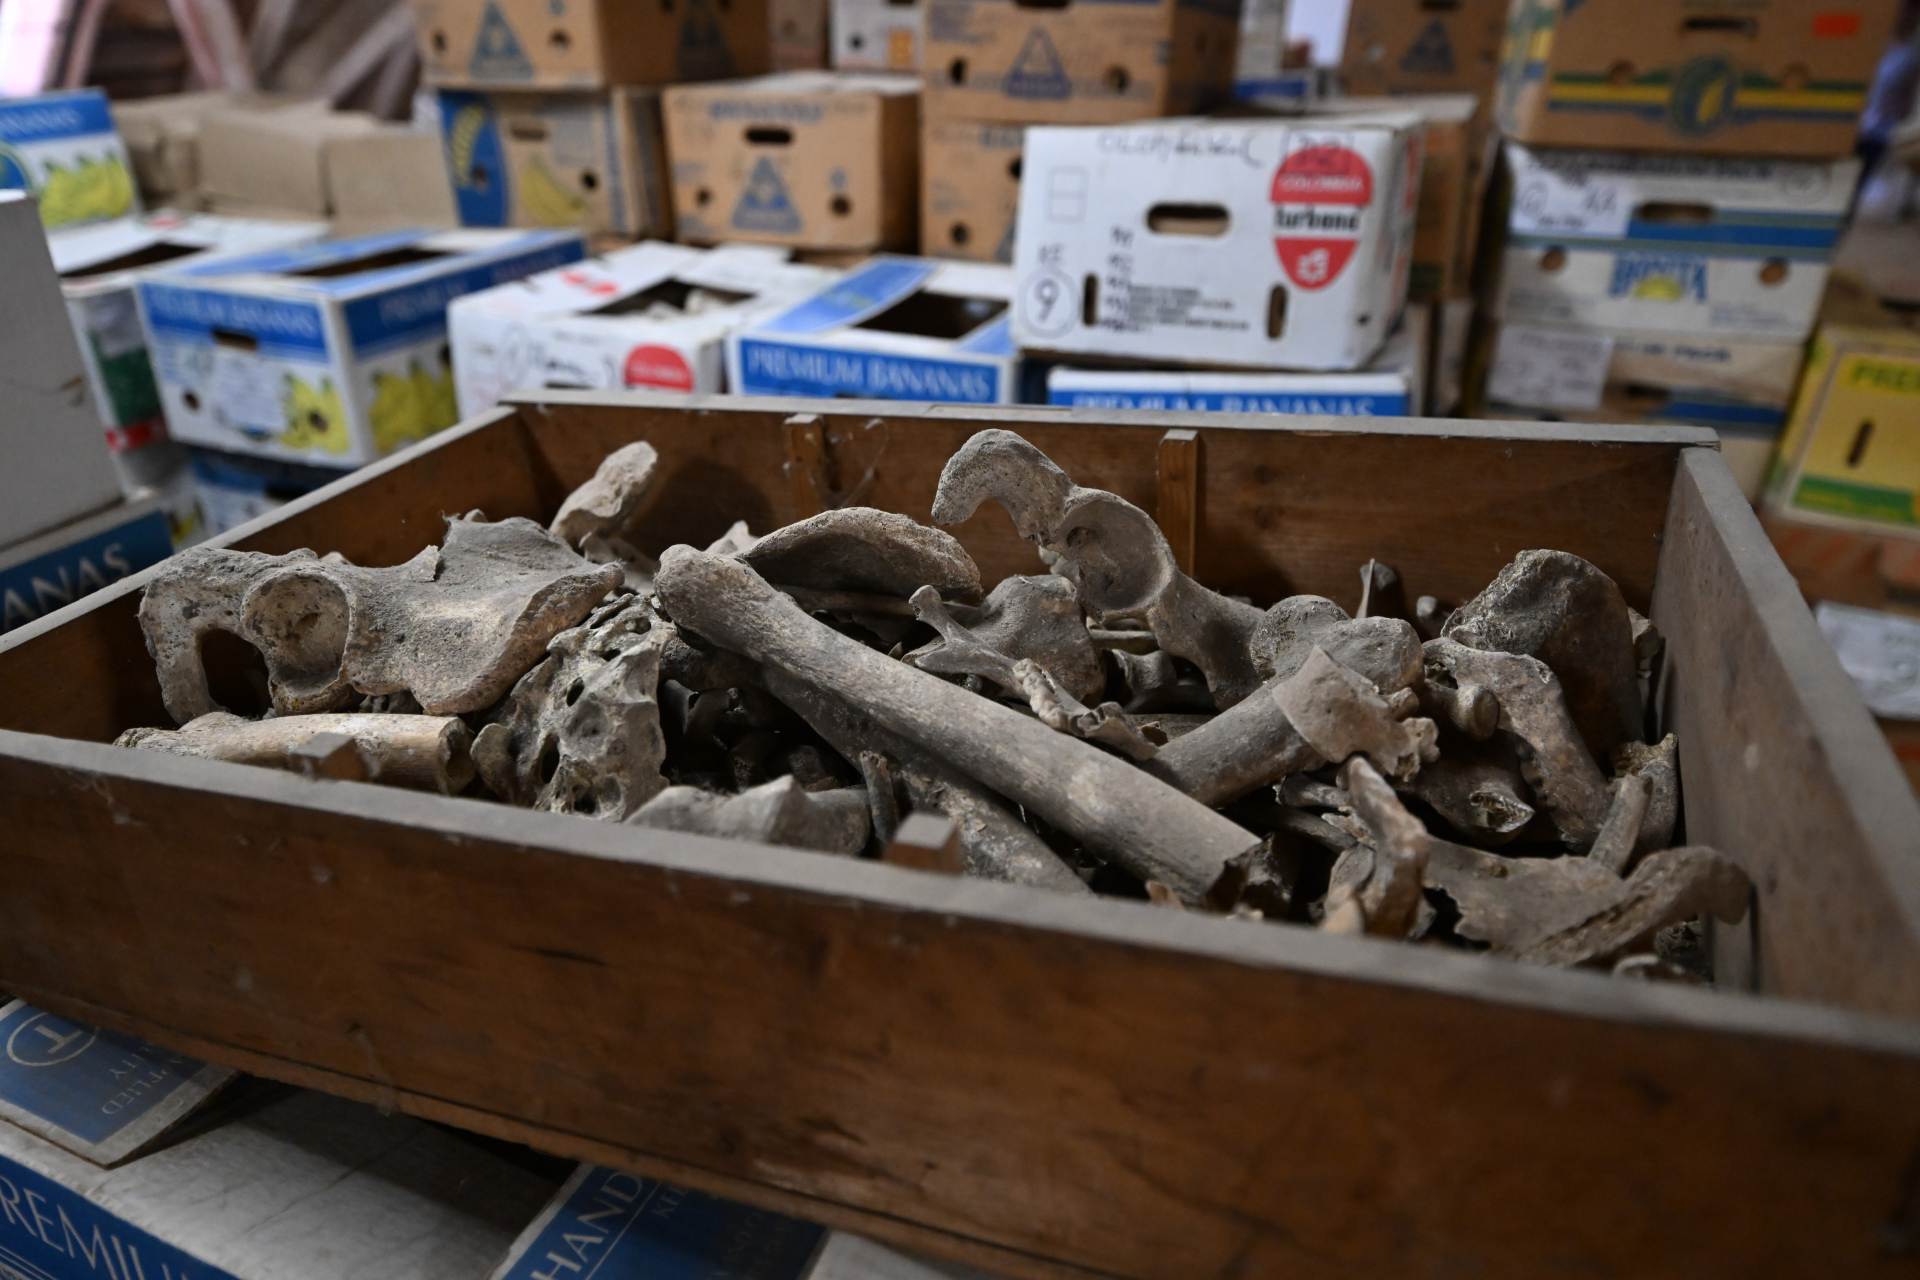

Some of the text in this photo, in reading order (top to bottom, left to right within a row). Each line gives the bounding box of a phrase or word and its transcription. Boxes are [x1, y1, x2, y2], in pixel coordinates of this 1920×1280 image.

[1034, 277, 1060, 323] 9
[749, 346, 991, 402] PREMIUM BANANAS
